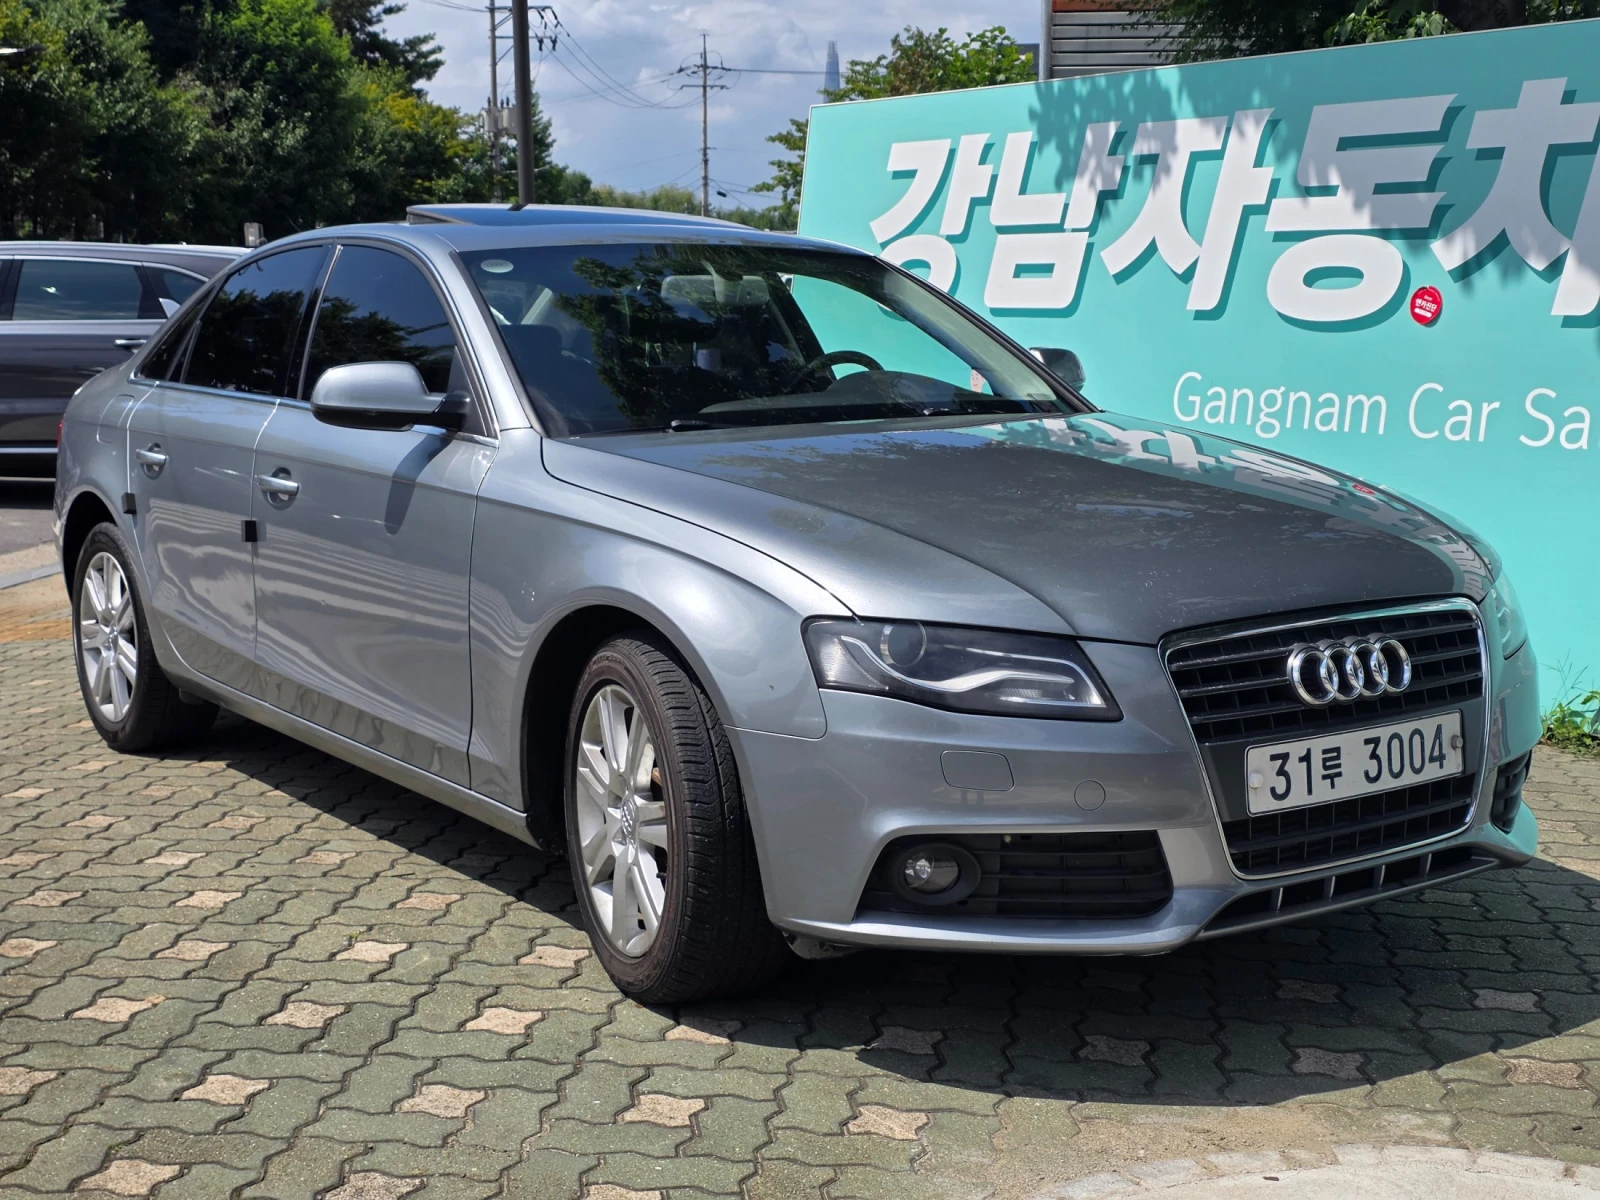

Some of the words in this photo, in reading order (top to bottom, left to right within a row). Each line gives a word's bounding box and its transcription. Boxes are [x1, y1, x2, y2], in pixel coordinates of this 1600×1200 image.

[1173, 371, 1387, 438] Gangnam
[1408, 382, 1500, 442] Car
[1519, 387, 1600, 450] Sa
[1269, 746, 1343, 801] 31루
[1363, 723, 1446, 784] 3004
